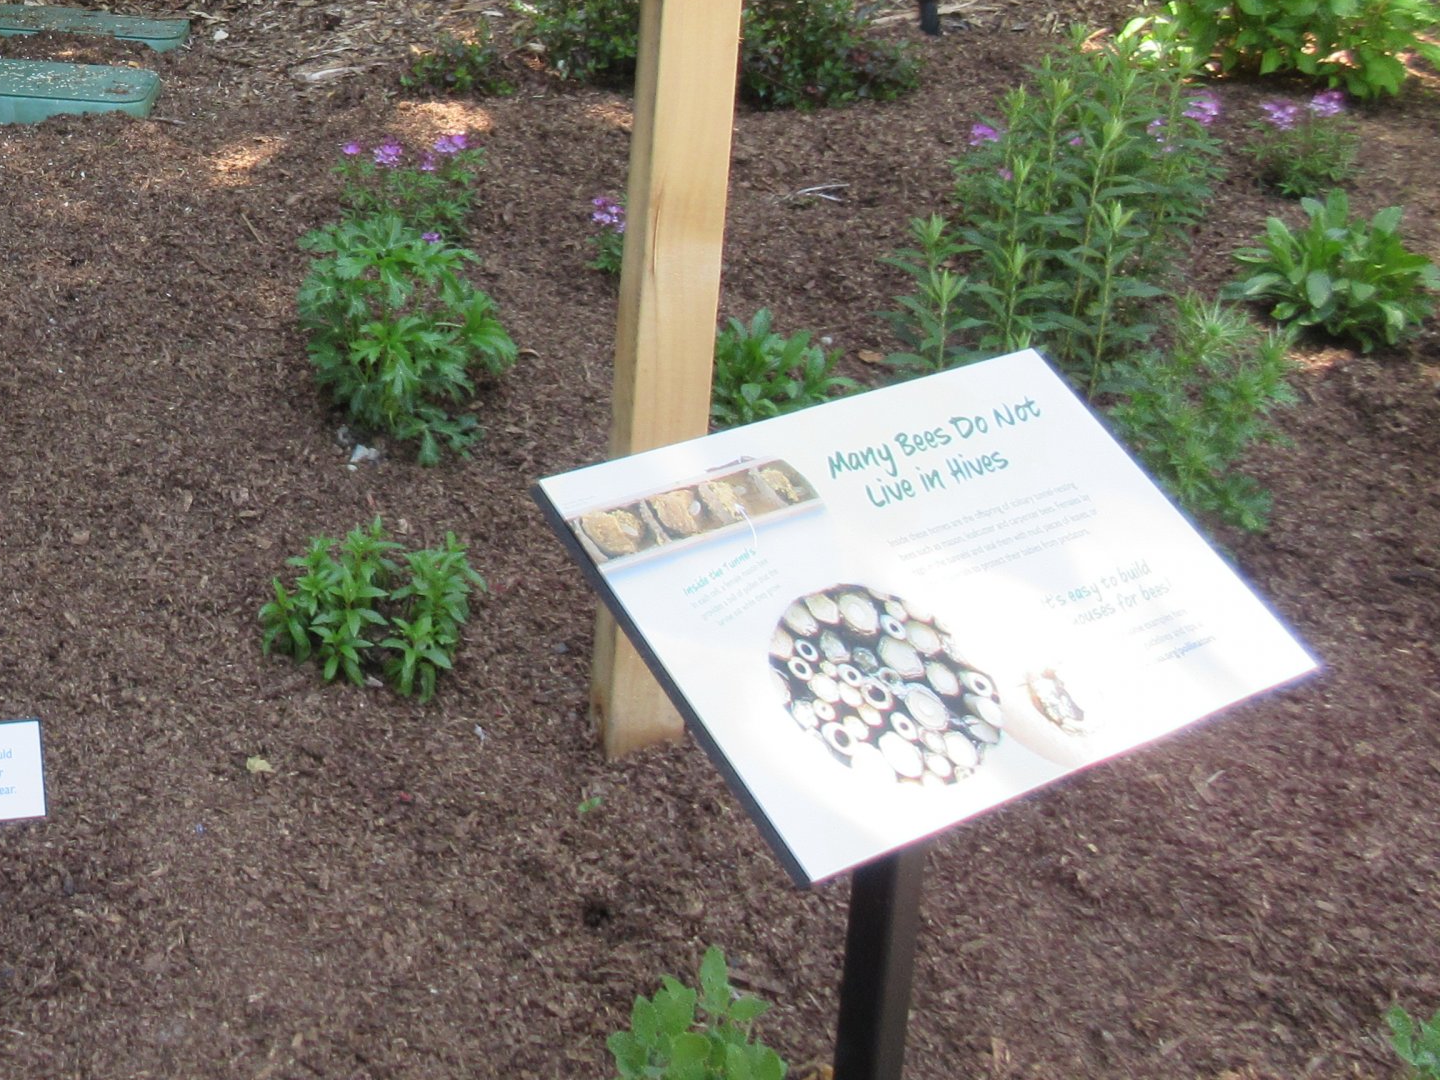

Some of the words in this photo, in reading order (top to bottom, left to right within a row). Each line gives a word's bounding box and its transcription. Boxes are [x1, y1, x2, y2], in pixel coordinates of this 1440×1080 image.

[828, 442, 897, 480] Many
[894, 426, 951, 457] Bees
[948, 415, 989, 439] Do
[992, 395, 1041, 428] Not
[865, 478, 916, 508] Live
[916, 466, 944, 492] in
[948, 451, 1010, 484] Hives
[1041, 593, 1066, 608] t's
[1067, 581, 1103, 602] easy
[1101, 576, 1118, 590] to
[1117, 559, 1152, 583] build
[1118, 592, 1138, 612] for
